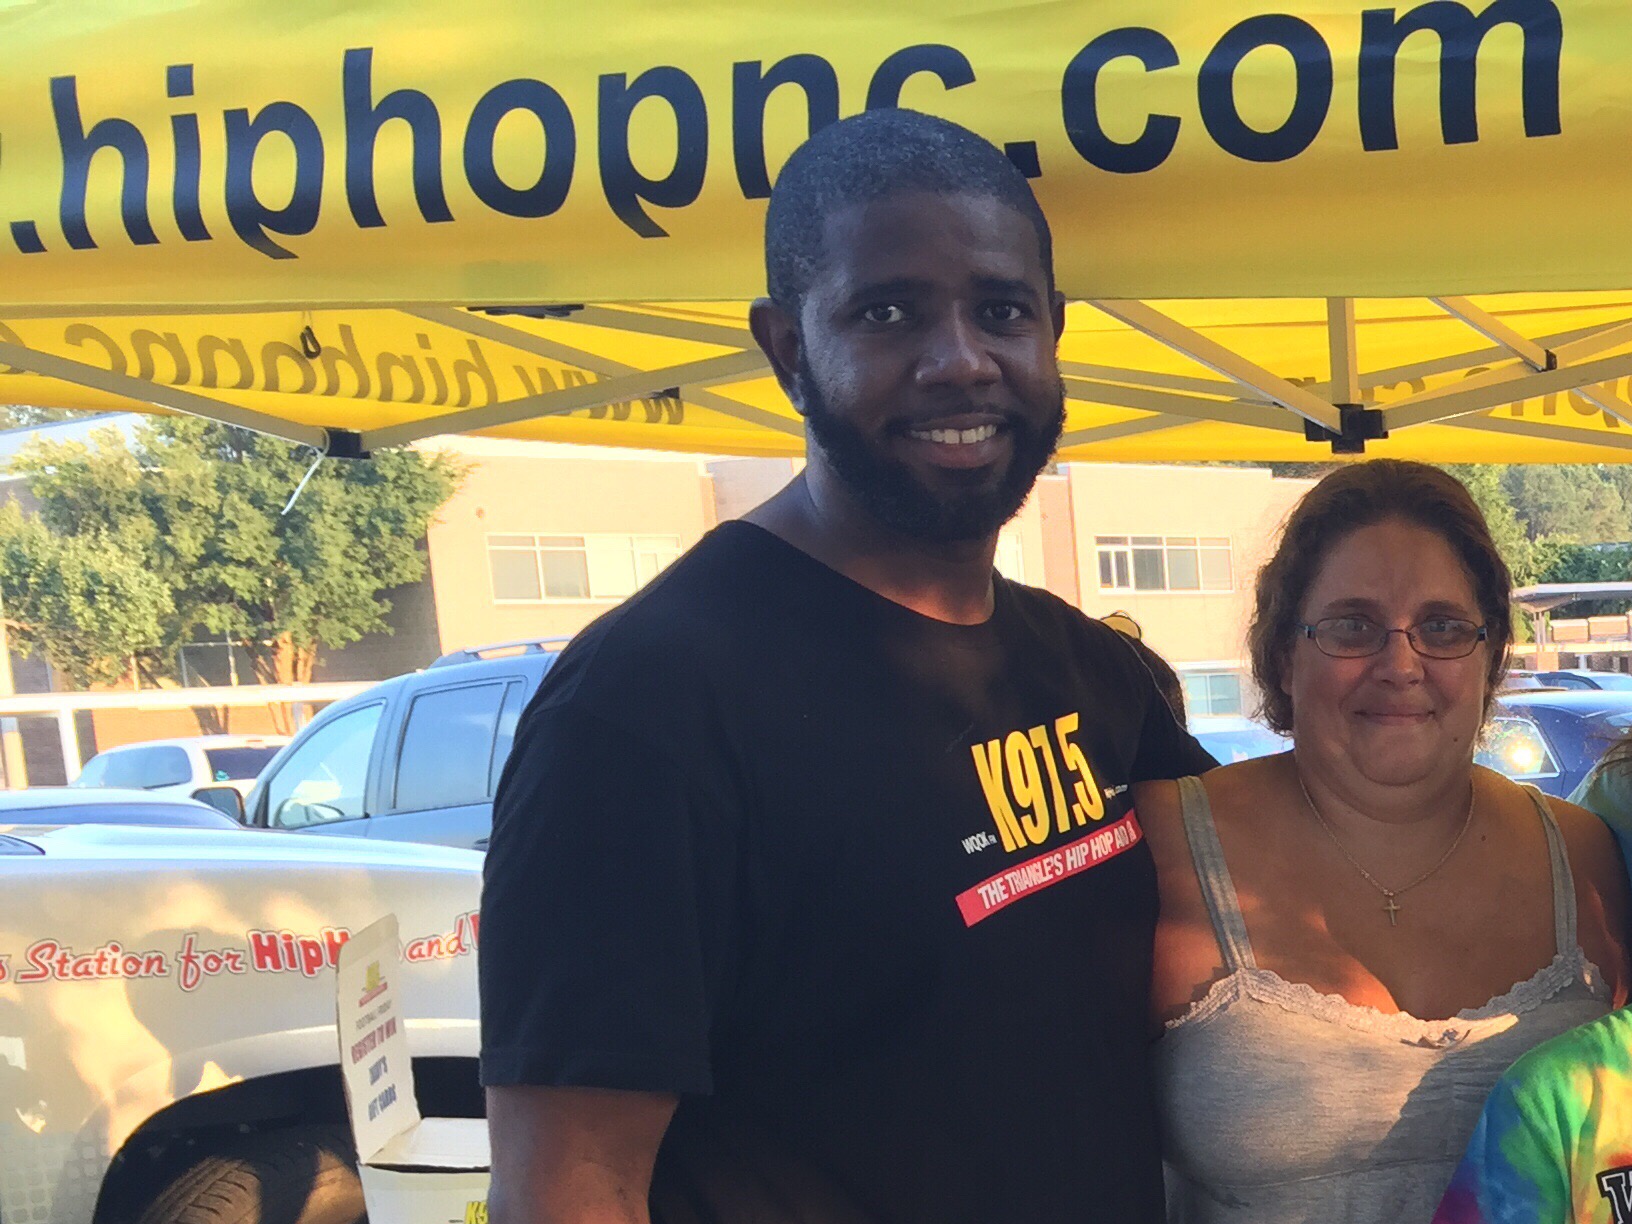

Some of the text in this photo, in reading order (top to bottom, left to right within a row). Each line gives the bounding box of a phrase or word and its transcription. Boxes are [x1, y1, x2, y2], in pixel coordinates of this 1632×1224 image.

[971, 712, 1105, 853] K97.5
[977, 877, 1009, 910] THE
[1005, 853, 1063, 896] TRIANGLE'S
[1066, 843, 1089, 872] HIP
[1091, 831, 1115, 861] HOP
[18, 940, 168, 981] Station
[179, 935, 244, 990] for
[250, 930, 350, 977] HipH
[406, 916, 468, 961] and
